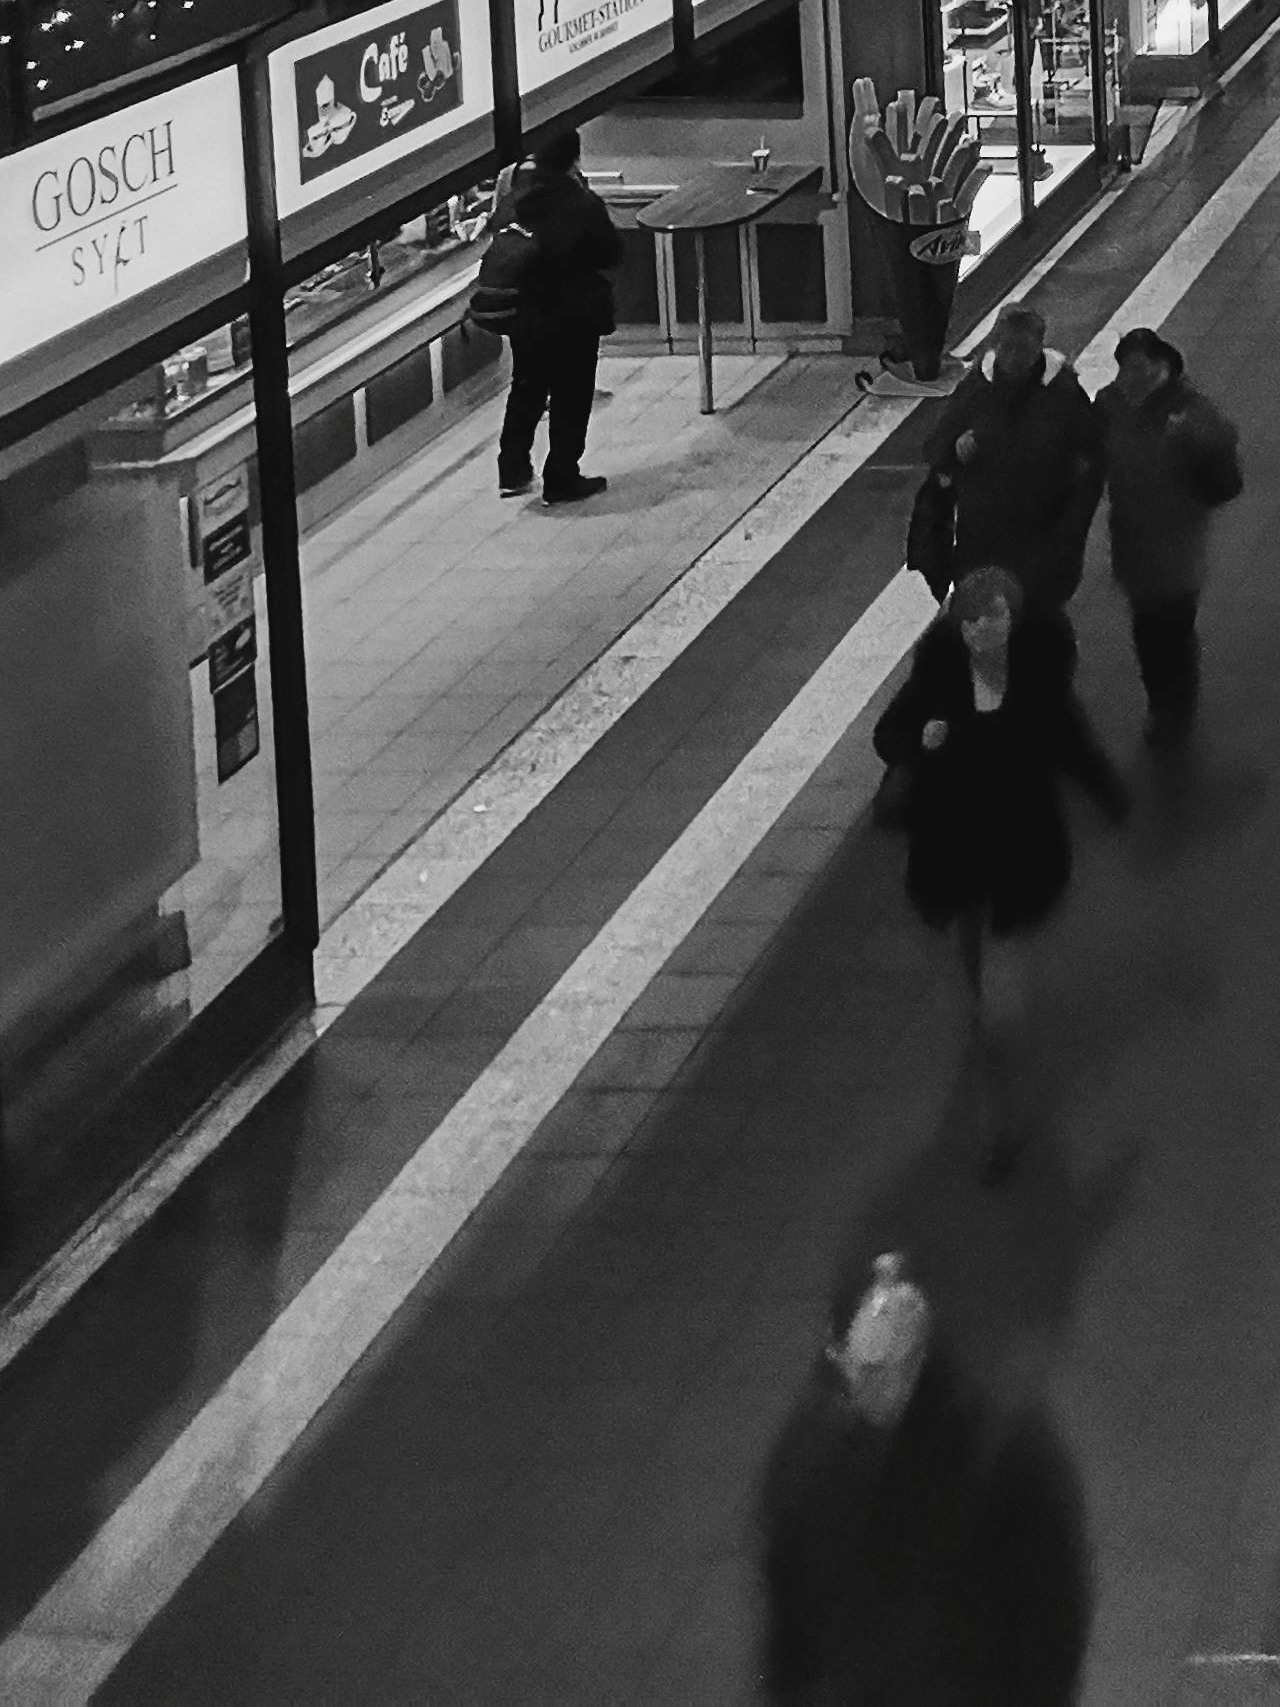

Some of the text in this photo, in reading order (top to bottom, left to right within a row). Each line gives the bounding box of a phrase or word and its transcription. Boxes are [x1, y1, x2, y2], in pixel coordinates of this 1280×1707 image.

[359, 31, 409, 104] Café
[32, 119, 176, 231] GOSCH
[71, 215, 149, 294] SYLT
